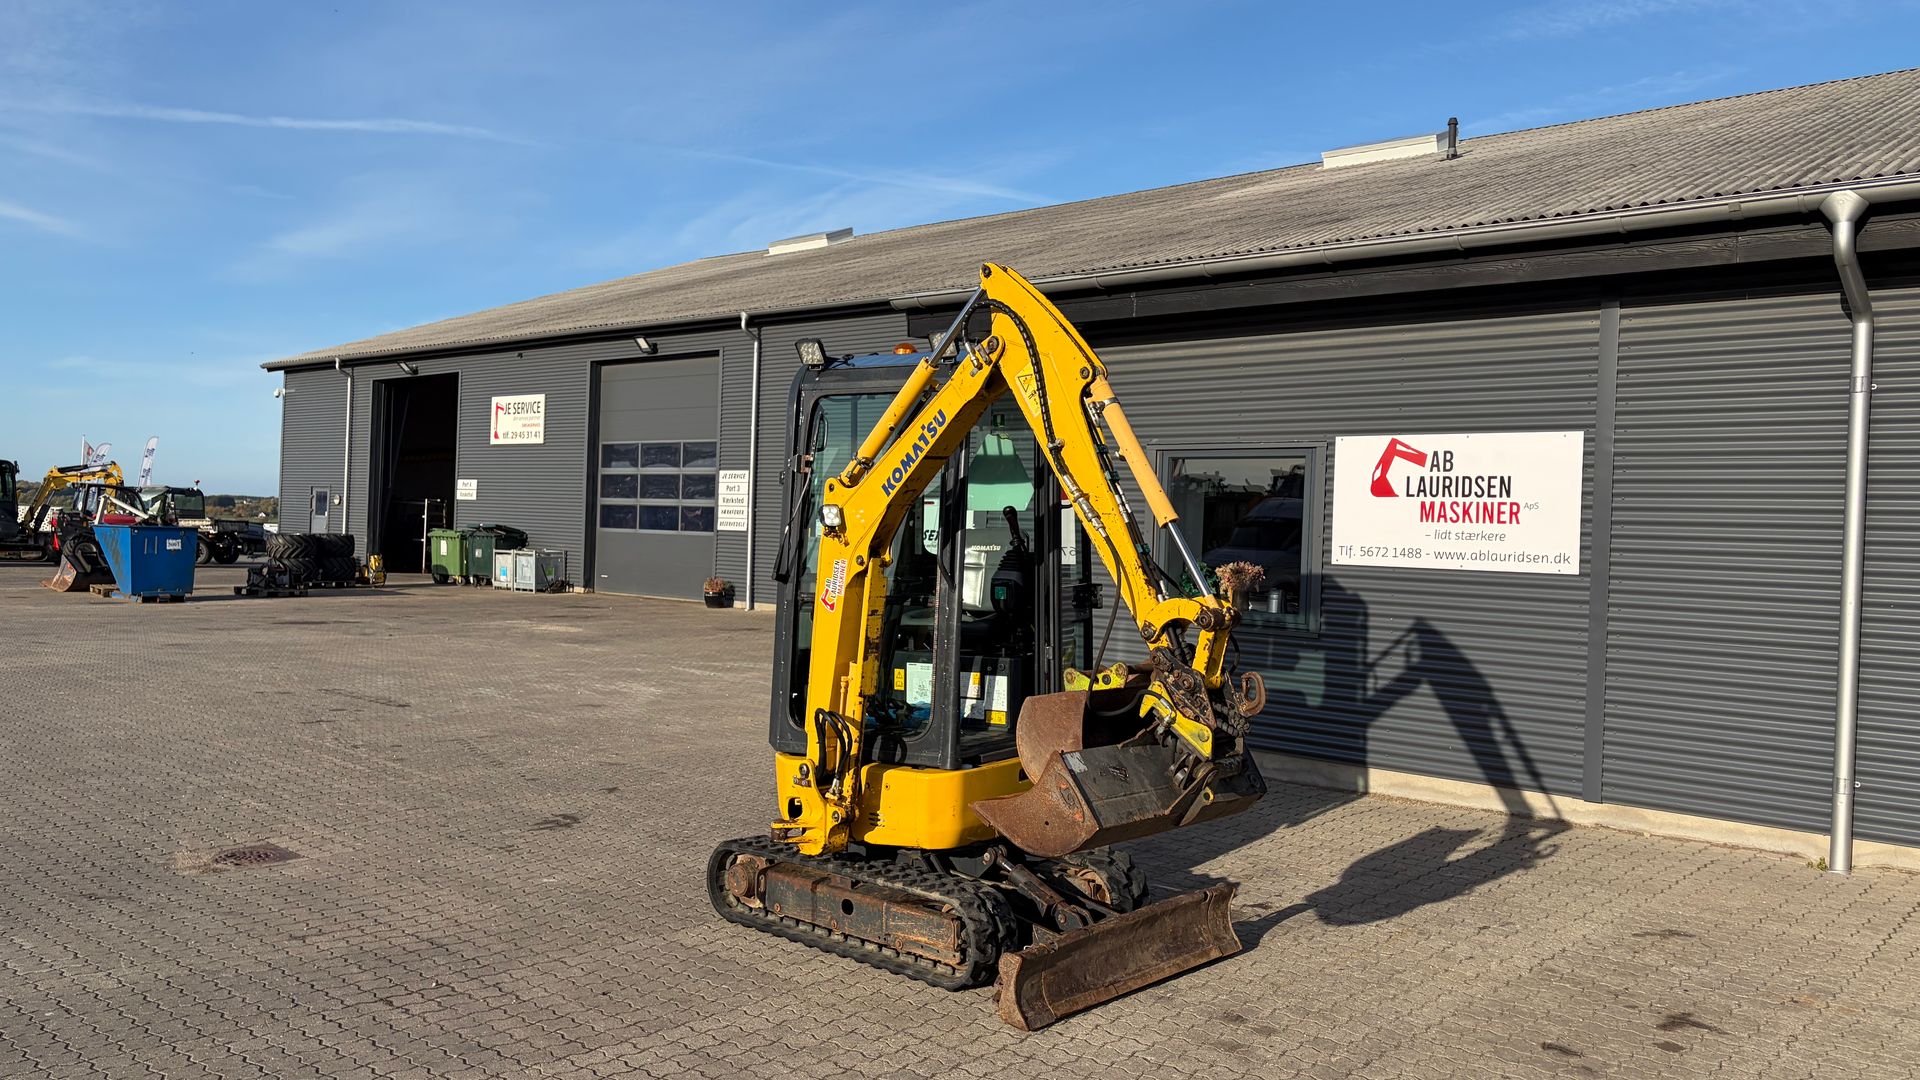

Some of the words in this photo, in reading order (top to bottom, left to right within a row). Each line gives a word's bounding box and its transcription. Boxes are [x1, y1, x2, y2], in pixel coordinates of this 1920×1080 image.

[504, 402, 511, 415] JE
[513, 401, 541, 415] SERVICE
[881, 408, 947, 498] KOMATSU
[1429, 450, 1454, 472] AB
[1406, 475, 1512, 498] LAURIDSEN
[1420, 500, 1521, 524] MASKINER
[1523, 502, 1540, 510] ApS
[1434, 529, 1451, 541] lidt
[1454, 530, 1507, 542] stærkere
[1339, 545, 1356, 559] Tlf.
[1360, 546, 1389, 558] 5672
[1392, 547, 1422, 559] 1488
[1434, 549, 1571, 565] www.ablauridsen.dk
